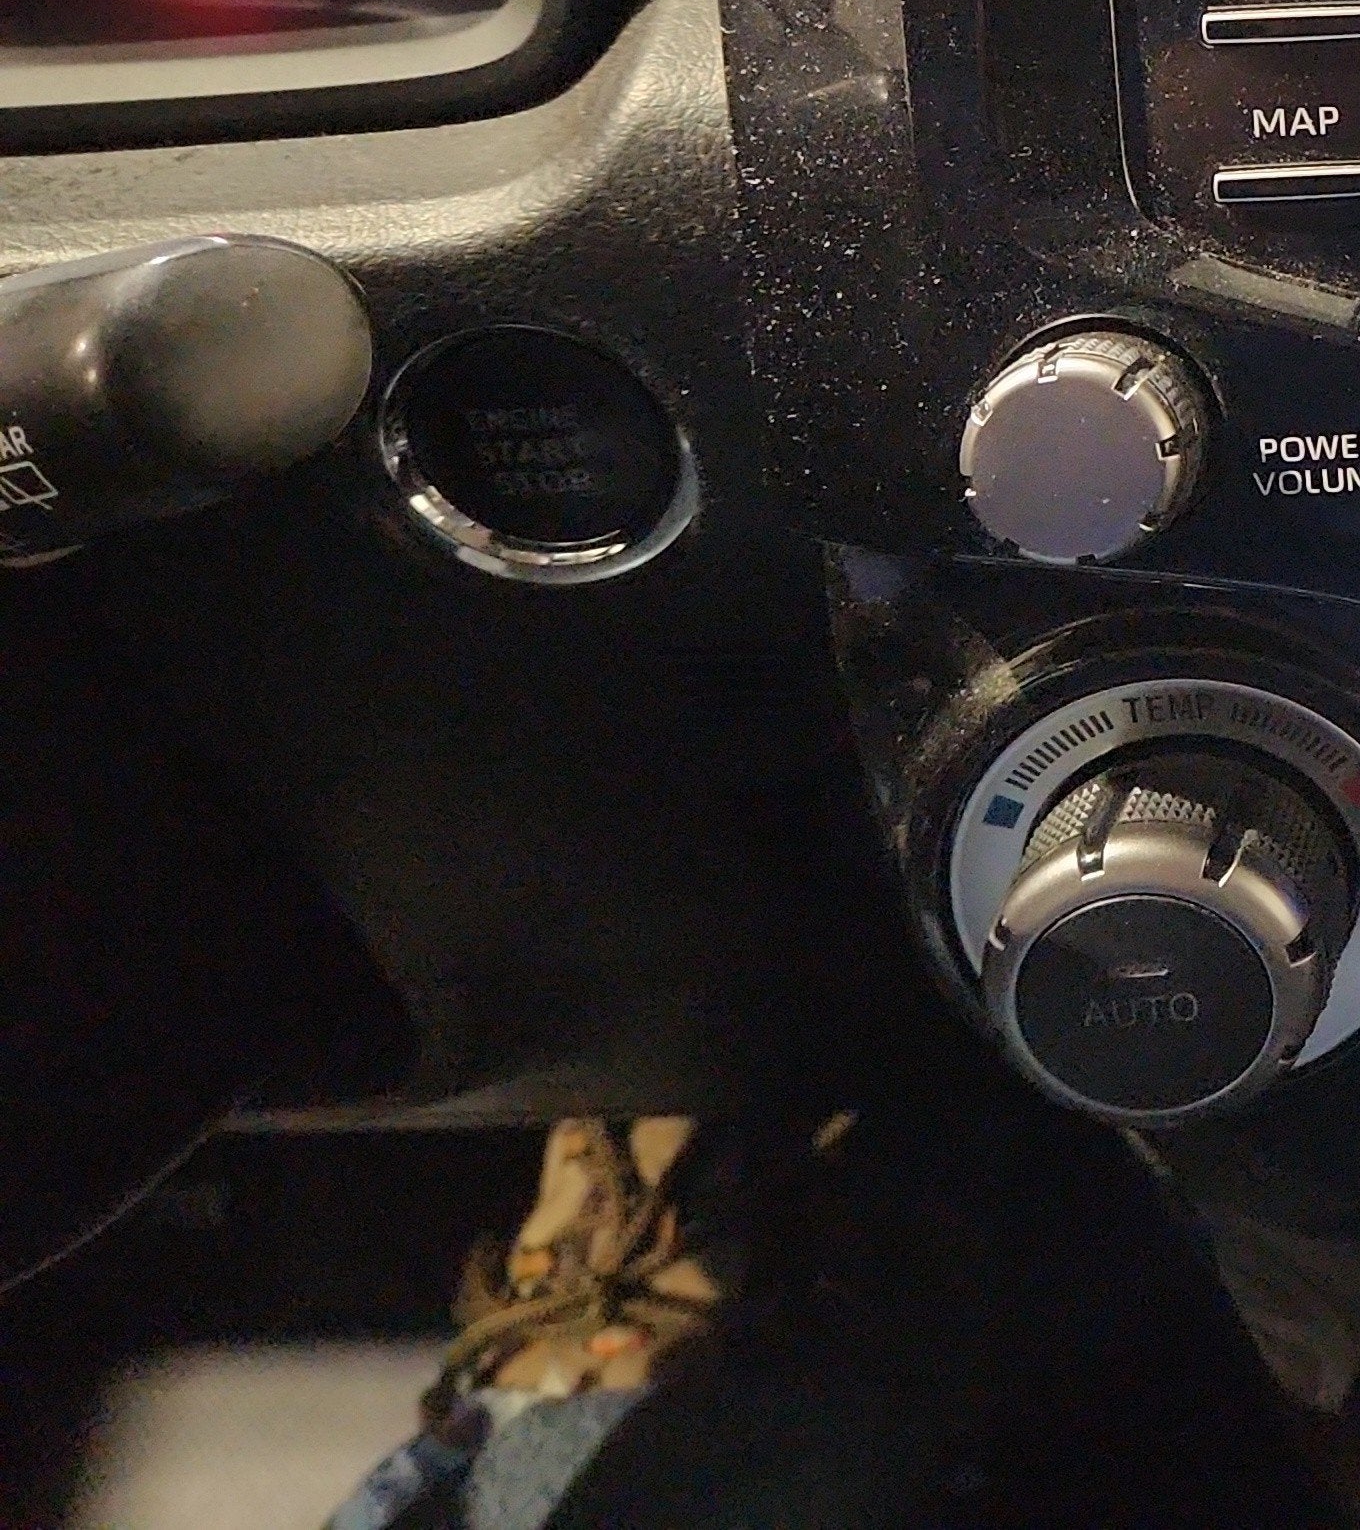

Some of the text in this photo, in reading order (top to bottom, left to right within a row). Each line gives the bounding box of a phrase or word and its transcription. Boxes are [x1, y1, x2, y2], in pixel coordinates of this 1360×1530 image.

[1252, 105, 1340, 140] MAP
[1122, 692, 1214, 724] TEMP
[1084, 991, 1199, 1027] AUTO
